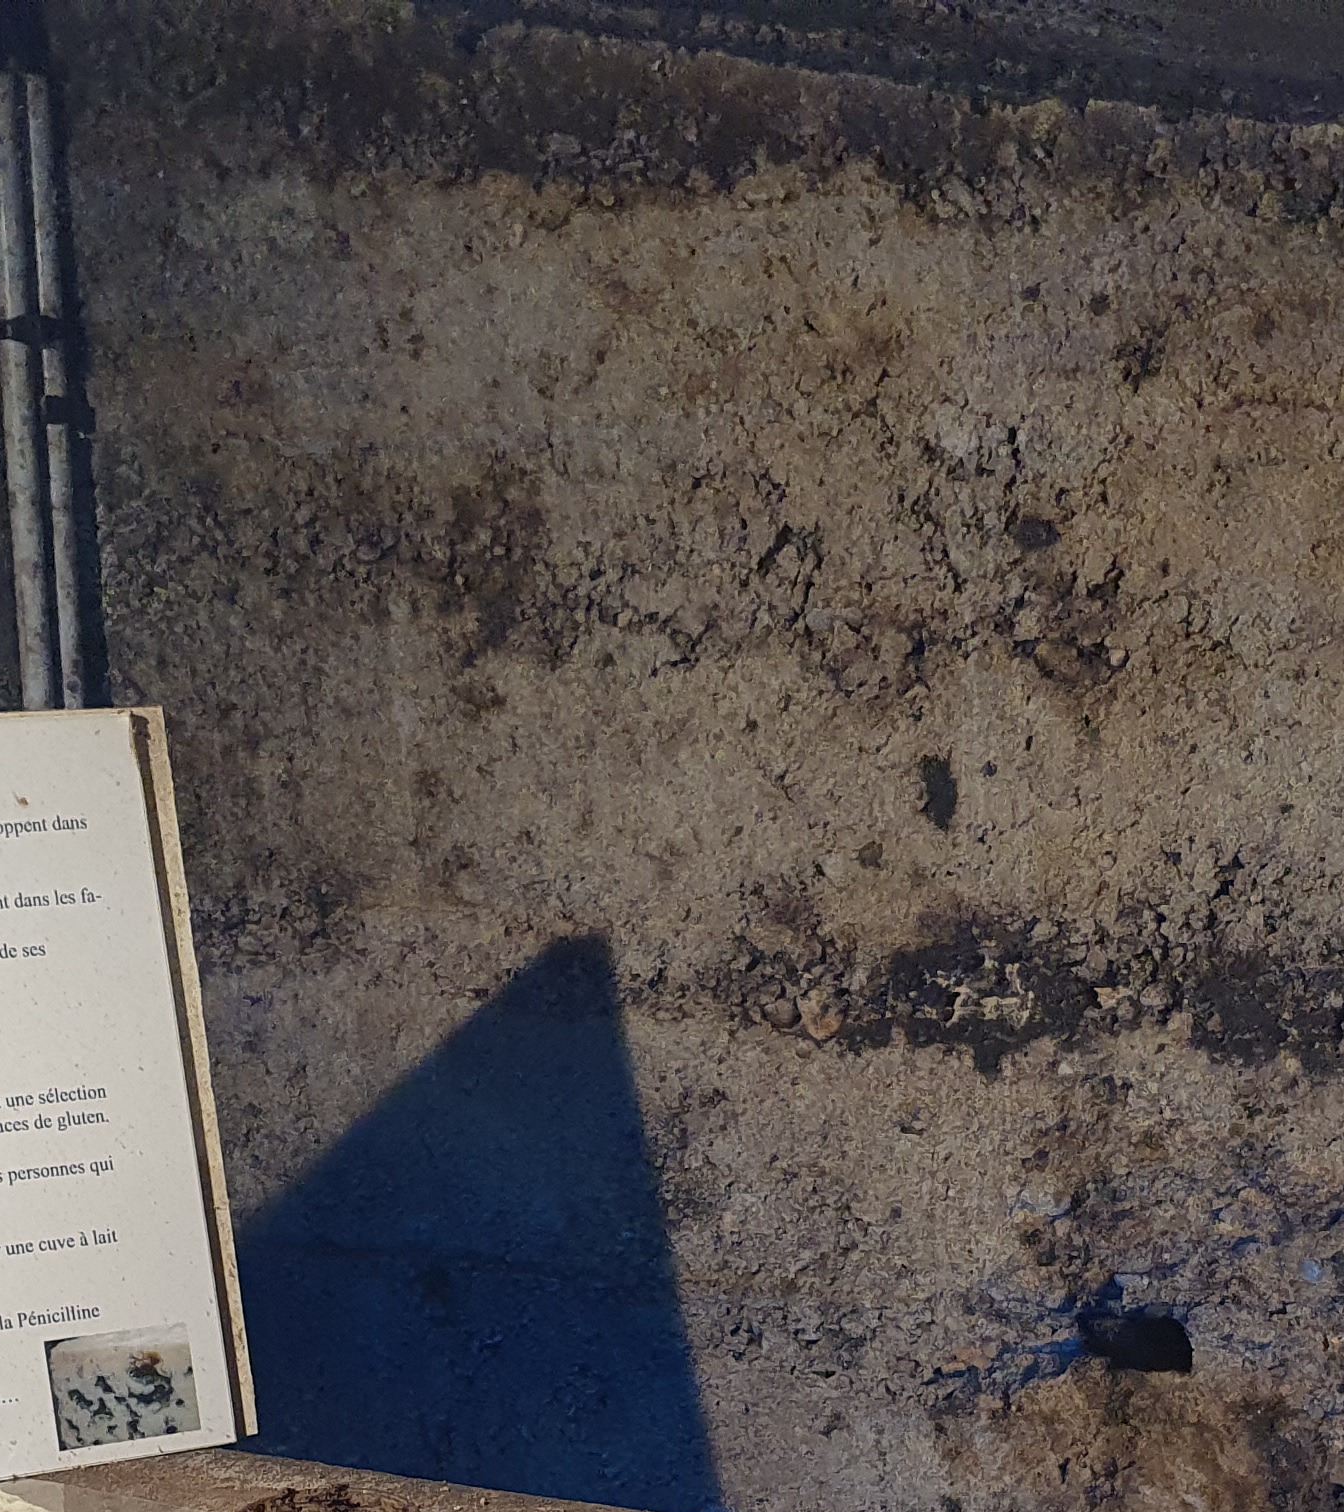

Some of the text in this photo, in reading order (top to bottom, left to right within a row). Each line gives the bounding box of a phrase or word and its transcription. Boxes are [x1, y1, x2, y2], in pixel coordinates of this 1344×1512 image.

[51, 814, 88, 831] dans
[21, 943, 47, 958] ses
[33, 1112, 53, 1130] de
[56, 1109, 110, 1132] gluten.
[4, 1241, 35, 1256] une
[37, 1236, 76, 1252] cuve
[78, 1230, 89, 1247] à
[91, 1227, 119, 1246] lait
[16, 1303, 101, 1329] Pénicilline
